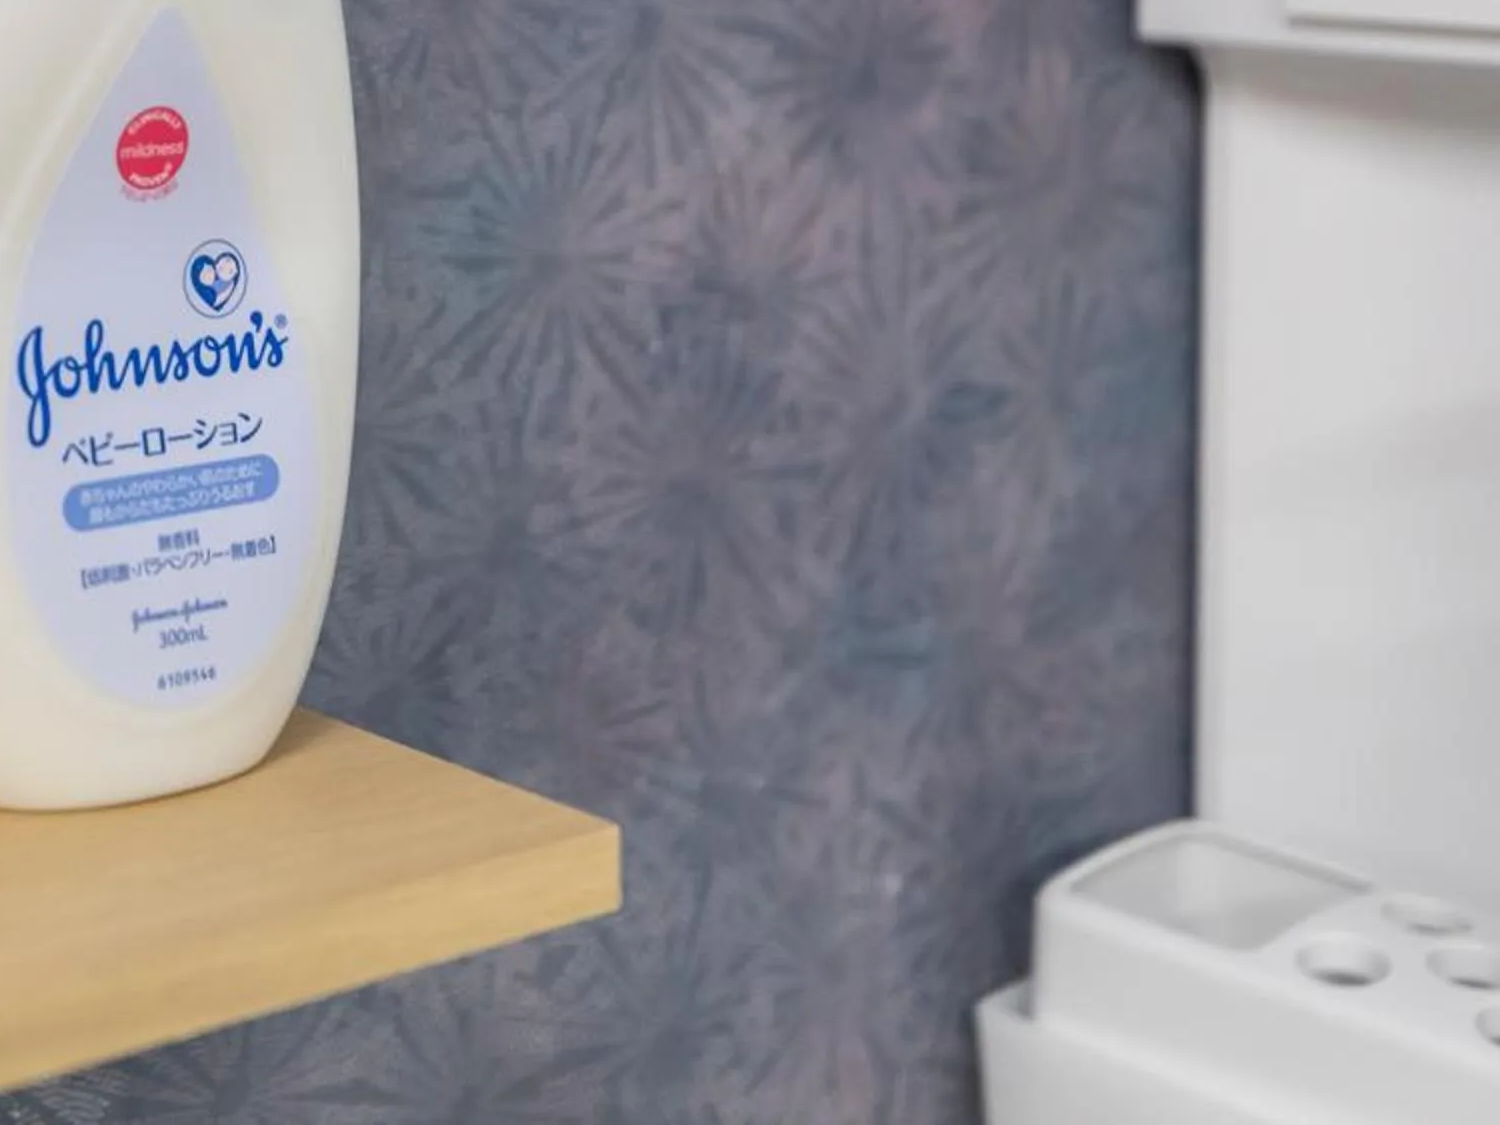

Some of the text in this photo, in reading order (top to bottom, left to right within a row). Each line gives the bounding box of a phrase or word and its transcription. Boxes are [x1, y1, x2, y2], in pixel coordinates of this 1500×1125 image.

[119, 141, 184, 160] mildness
[62, 411, 263, 467] ベビーローション
